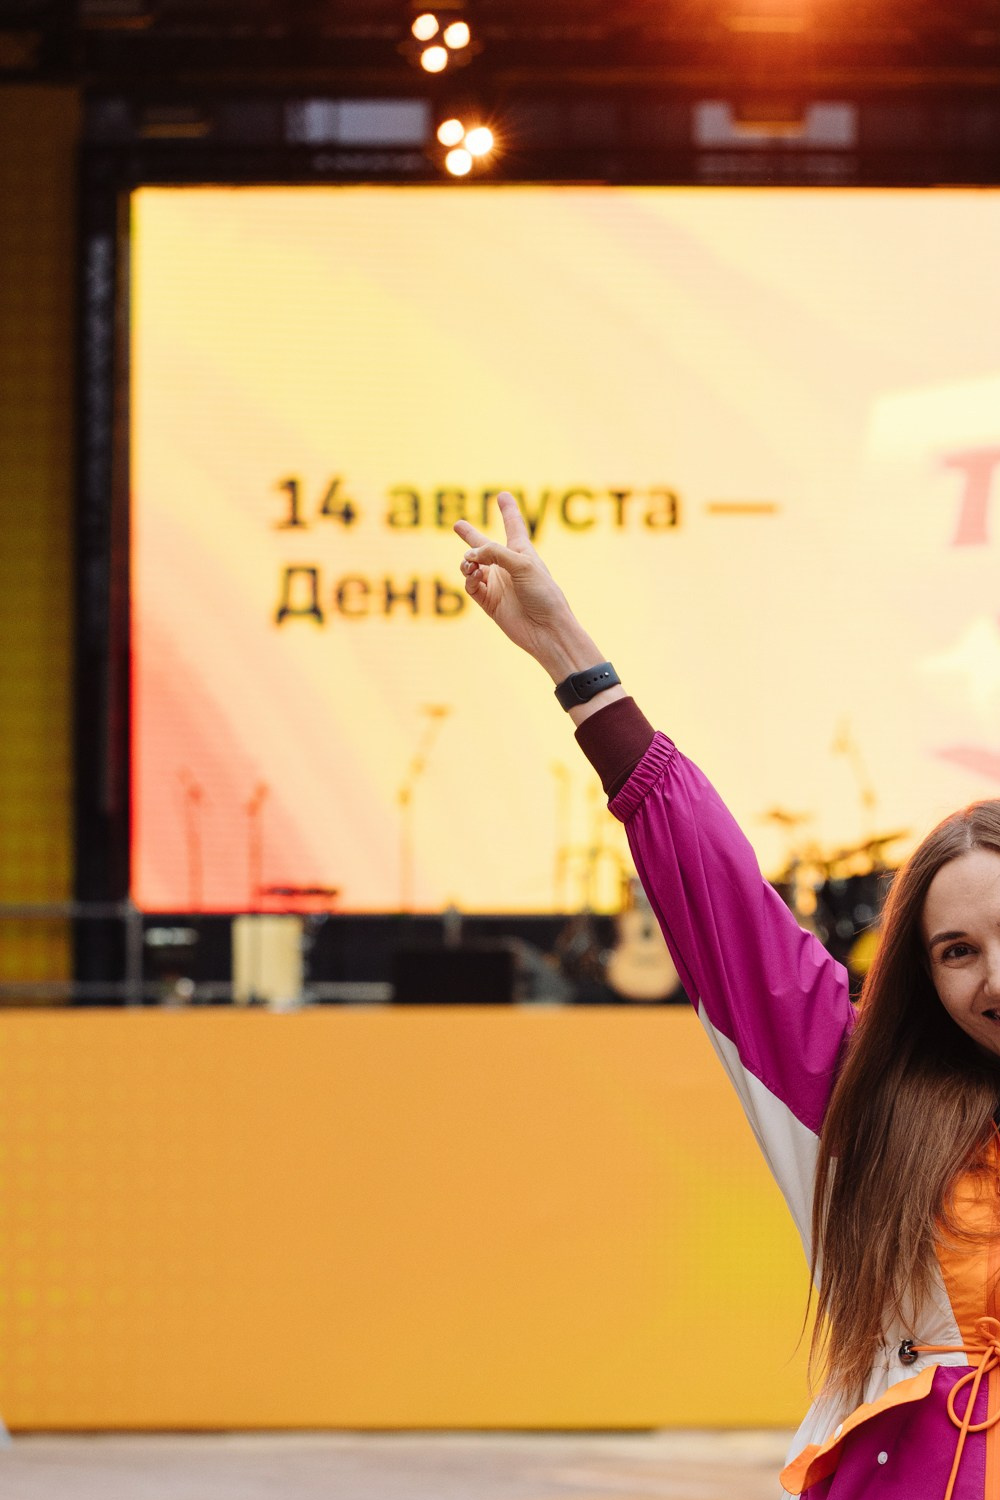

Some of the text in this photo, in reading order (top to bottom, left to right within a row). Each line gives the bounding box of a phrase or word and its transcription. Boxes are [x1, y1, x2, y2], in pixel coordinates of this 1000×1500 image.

[275, 477, 355, 530] 14
[388, 487, 680, 540] августа
[275, 566, 466, 625] День
